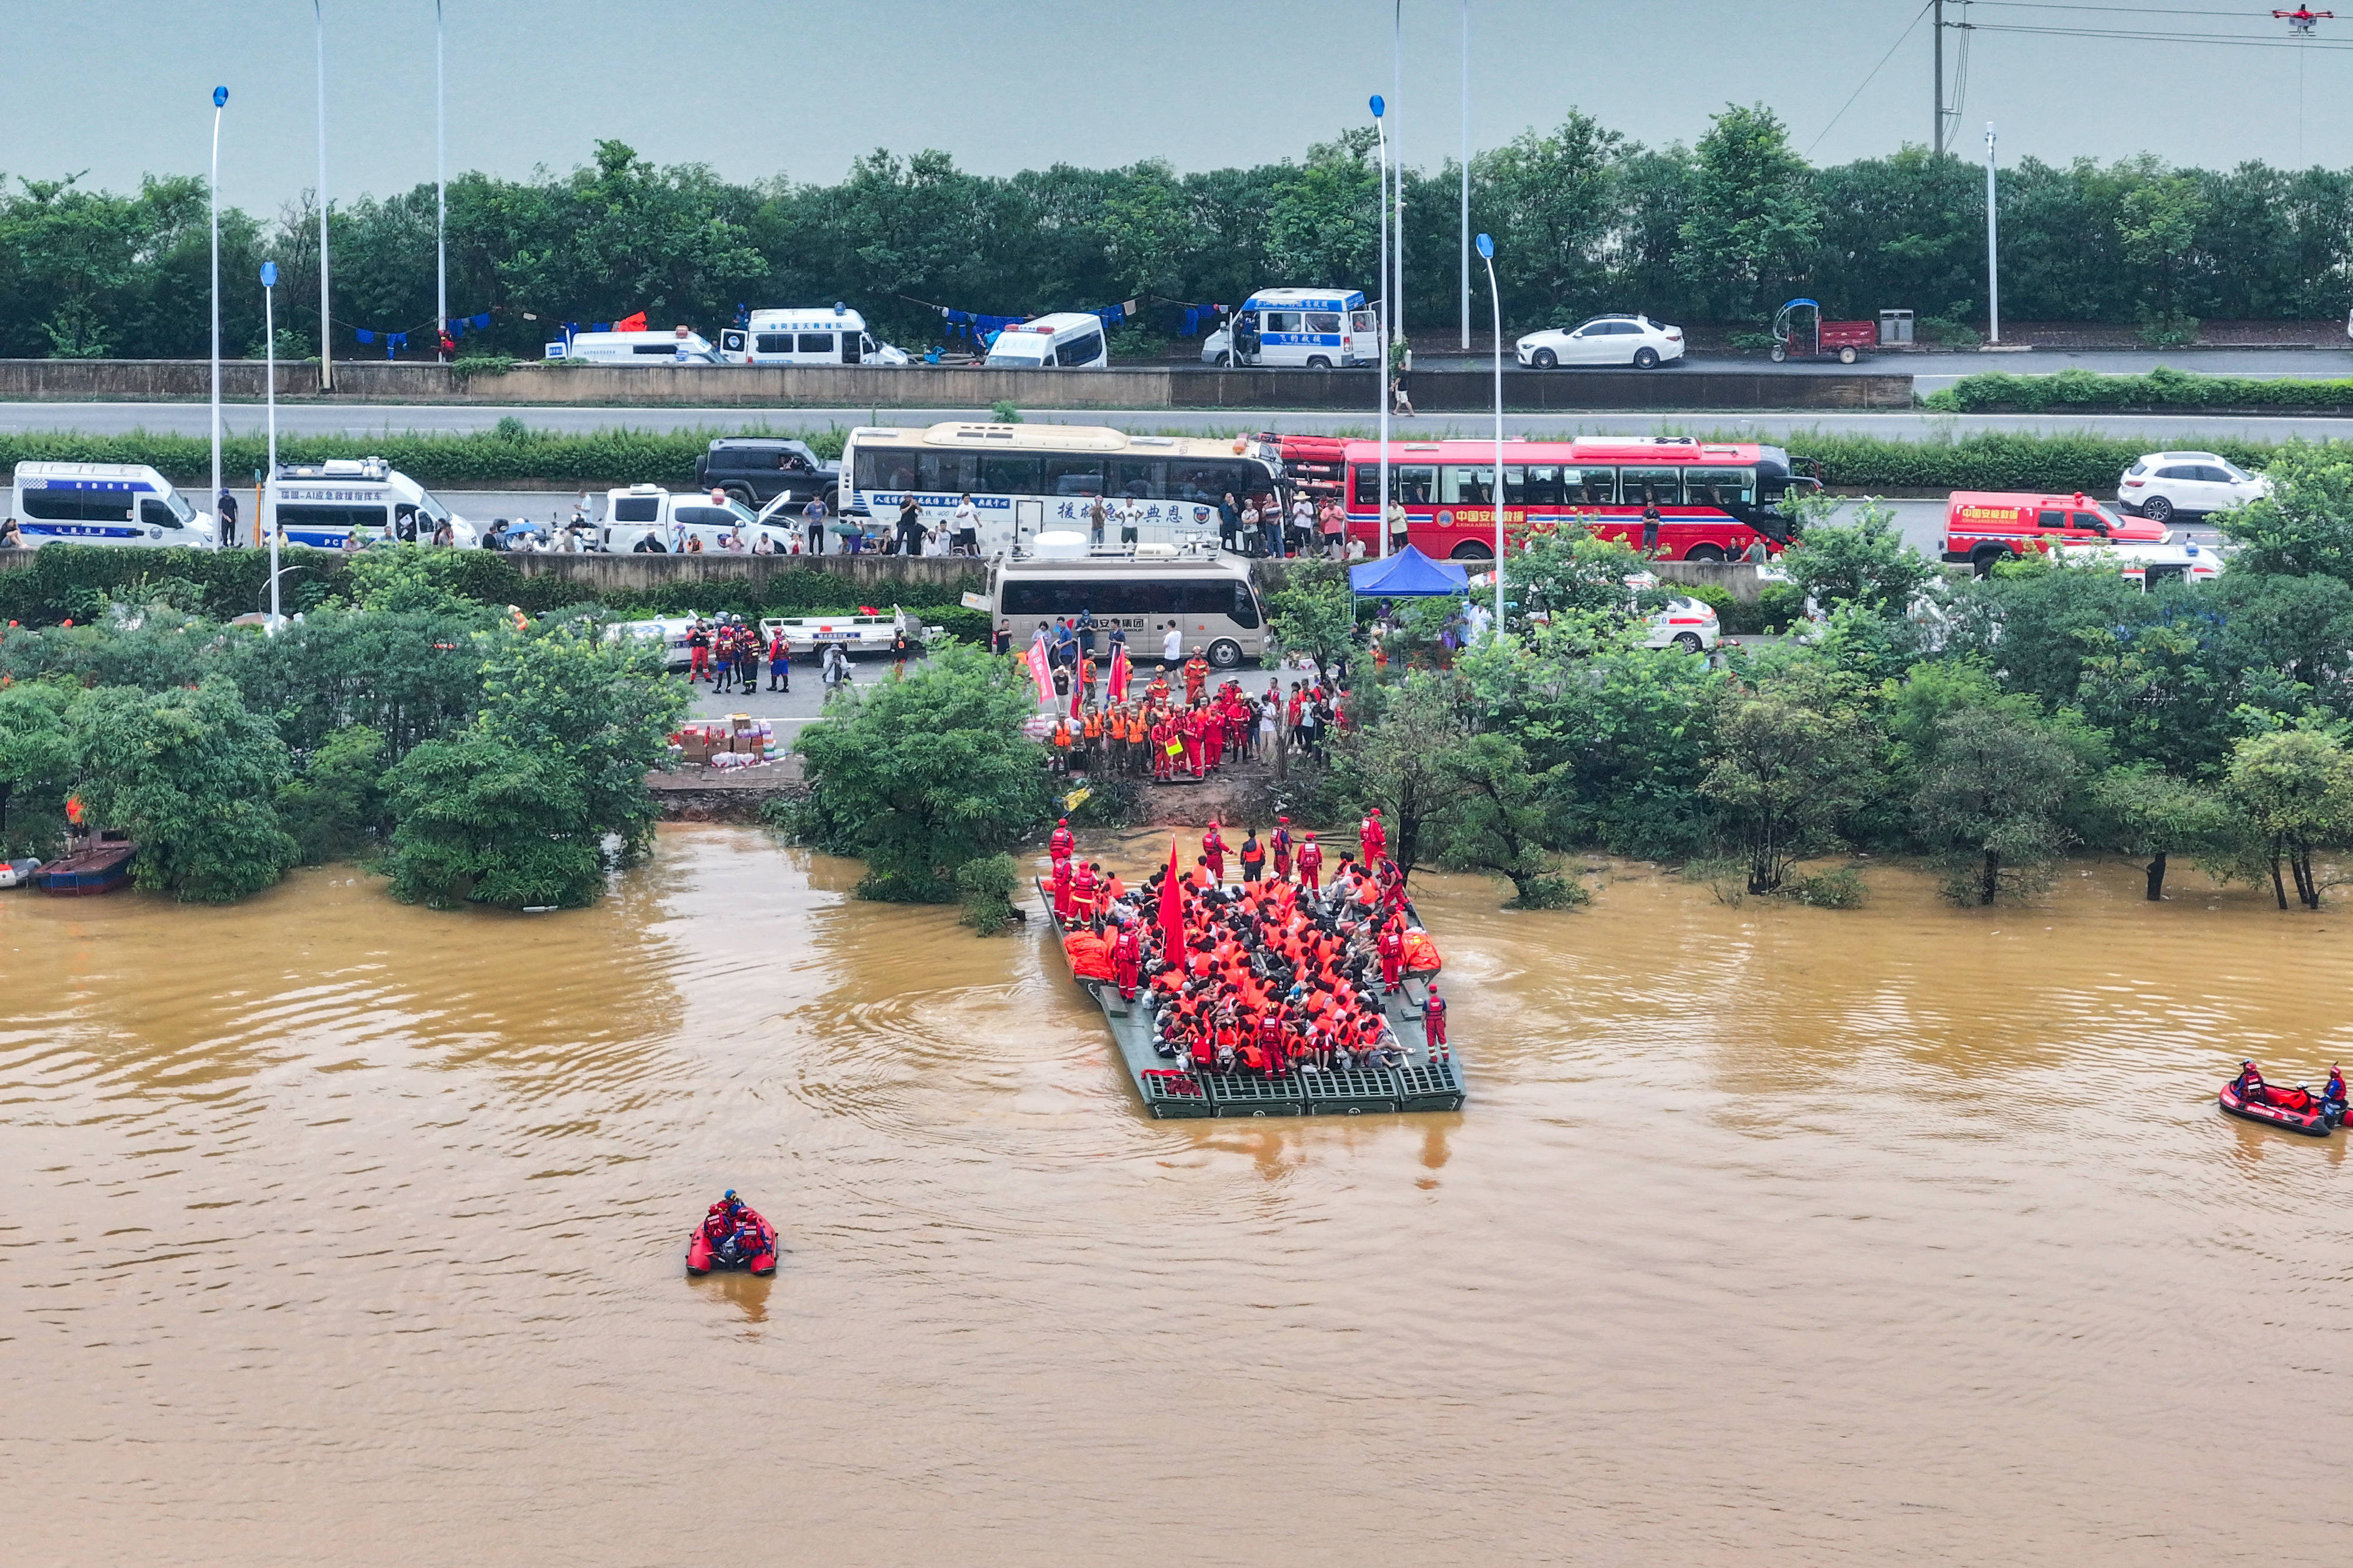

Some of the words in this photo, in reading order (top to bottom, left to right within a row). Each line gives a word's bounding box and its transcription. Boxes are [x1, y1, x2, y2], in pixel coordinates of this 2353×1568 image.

[1279, 334, 1321, 342] 飞豹救援
[1962, 508, 2018, 519] 中国安能救援
